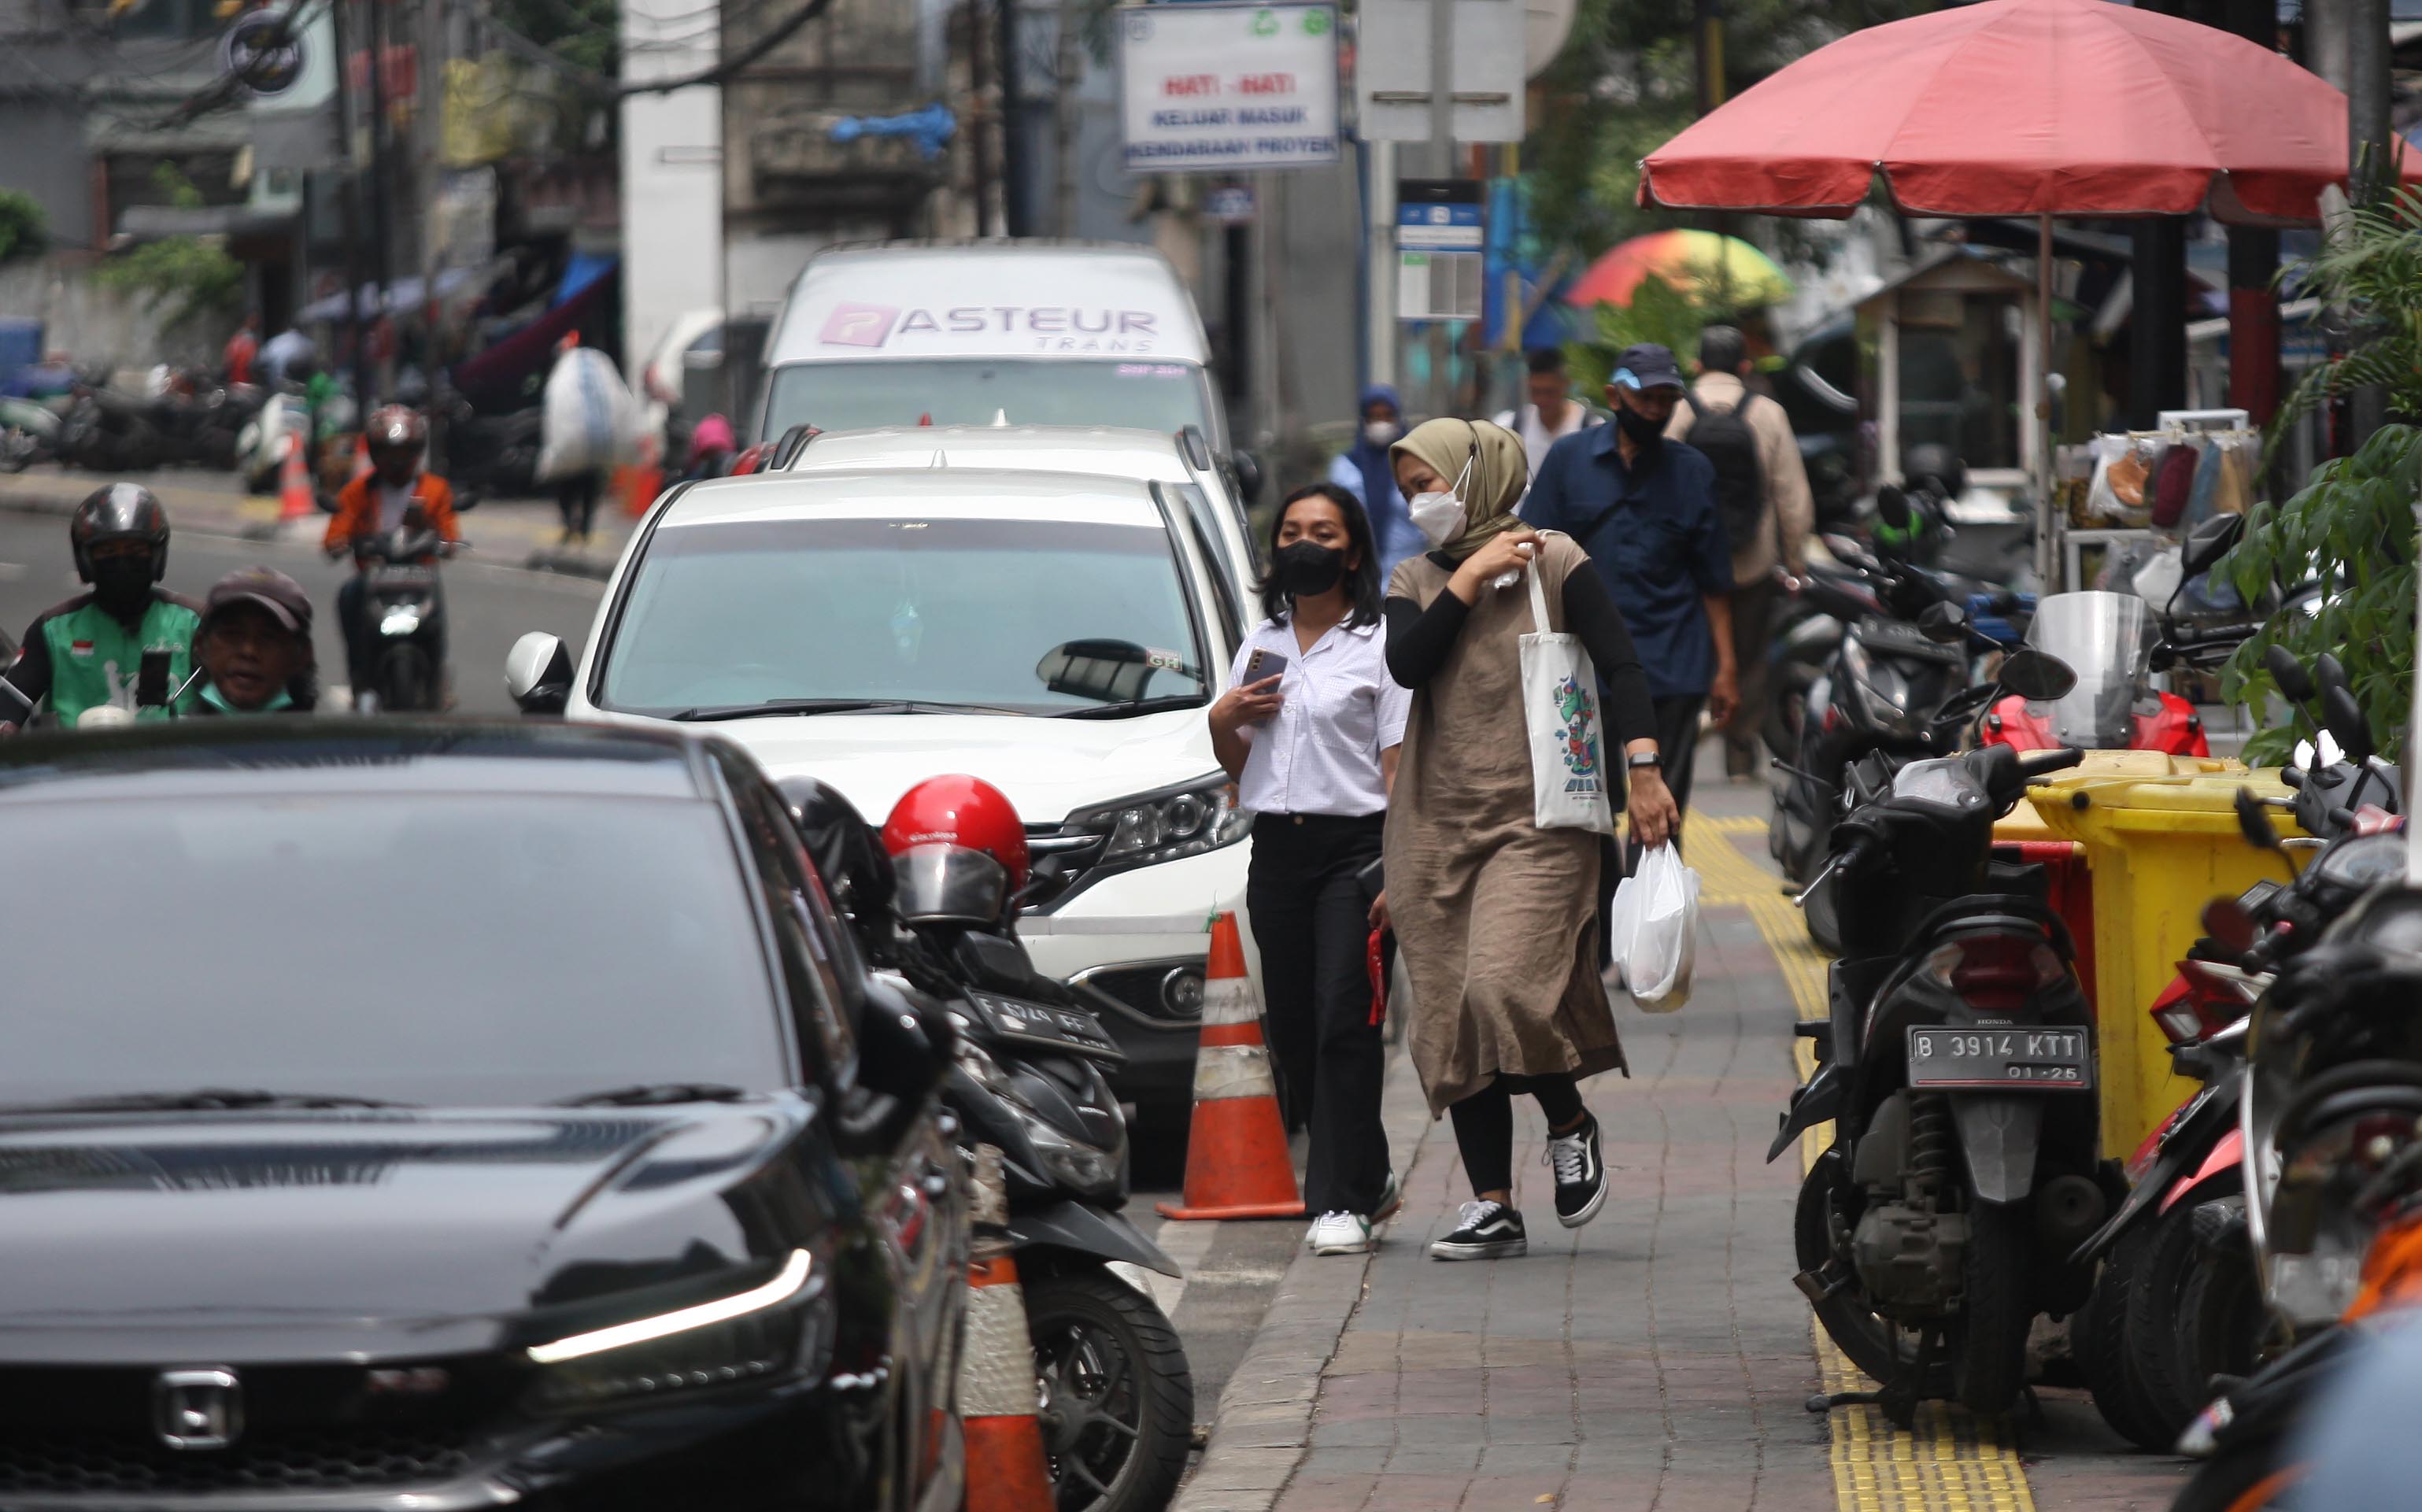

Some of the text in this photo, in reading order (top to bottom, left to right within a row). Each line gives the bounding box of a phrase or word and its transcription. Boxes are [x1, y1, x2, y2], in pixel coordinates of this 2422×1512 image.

[1163, 75, 1220, 96] HATI
[1152, 106, 1307, 126] KELUAR MASUK
[1255, 135, 1337, 154] PROYEK
[1036, 336, 1153, 353] TRANS
[1057, 1014, 1085, 1032] FF
[1919, 1034, 2076, 1057] B 3914 KTT
